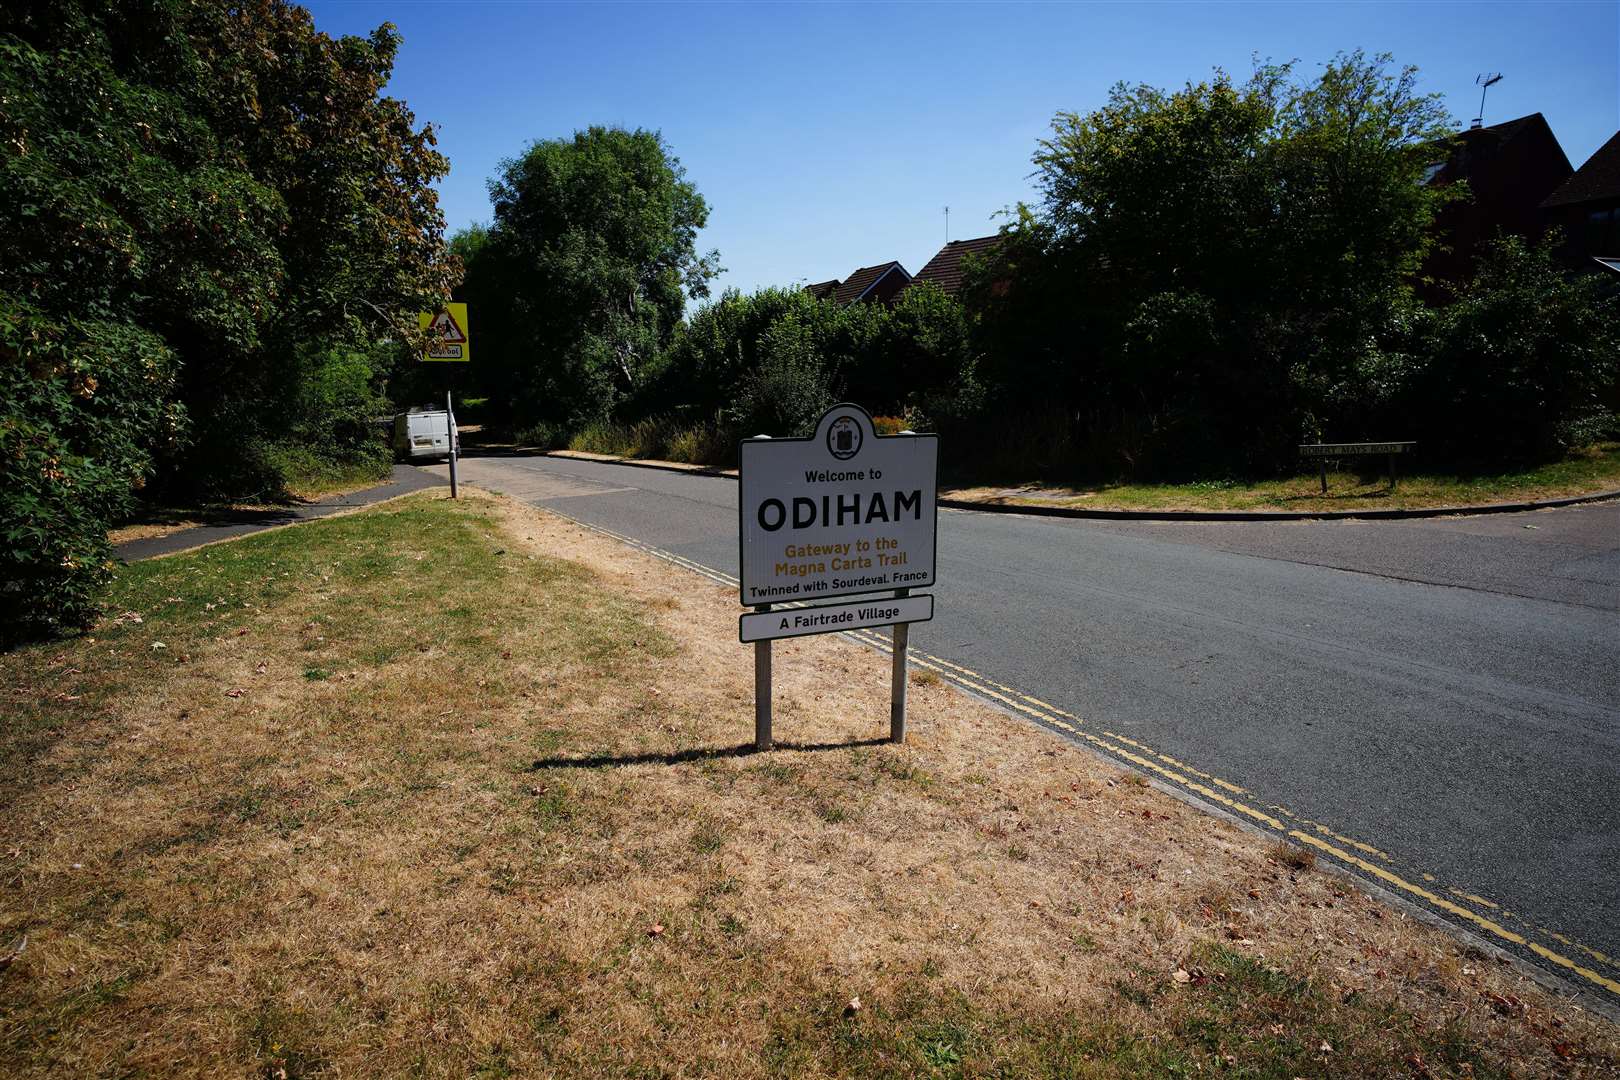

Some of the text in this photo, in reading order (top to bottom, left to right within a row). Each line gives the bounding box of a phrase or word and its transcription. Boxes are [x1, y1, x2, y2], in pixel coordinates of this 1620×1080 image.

[805, 469, 881, 482] Welcome to
[758, 490, 922, 531] ODIHAM
[785, 537, 897, 558] Gateway to the
[776, 552, 907, 576] Magna Carta Trail
[751, 584, 799, 597] Twinned
[803, 578, 827, 592] with
[893, 570, 927, 582] France
[780, 607, 899, 629] A Fairtrade Village
